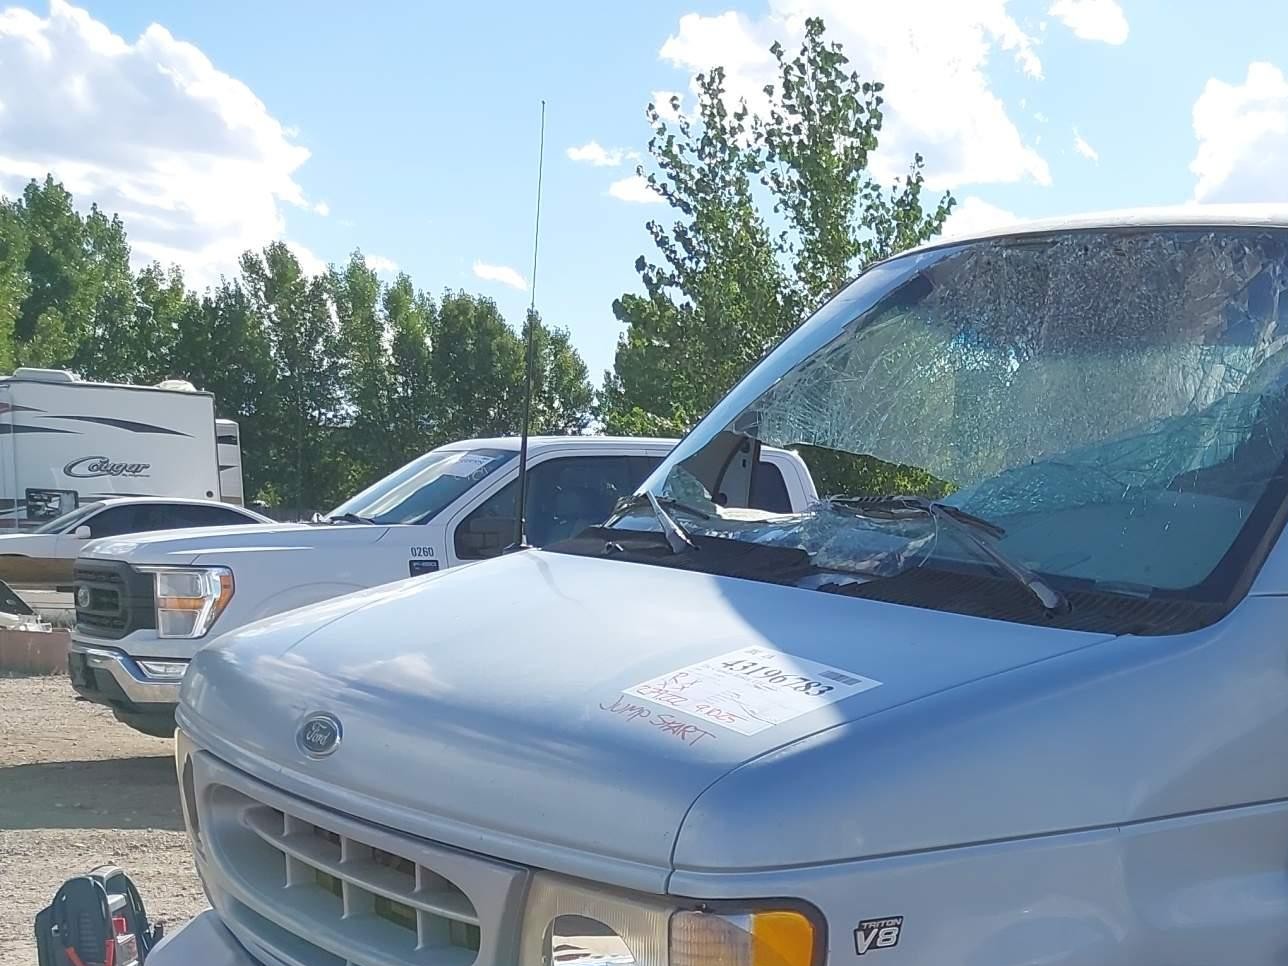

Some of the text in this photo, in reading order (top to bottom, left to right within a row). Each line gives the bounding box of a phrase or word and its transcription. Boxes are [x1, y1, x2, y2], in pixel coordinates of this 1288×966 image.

[63, 455, 151, 478] Cougar
[410, 546, 435, 557] 0260
[721, 659, 835, 697] 43196783
[306, 721, 331, 746] Ford
[648, 714, 717, 747] START
[861, 917, 902, 930] TRITON
[856, 926, 900, 954] V8
